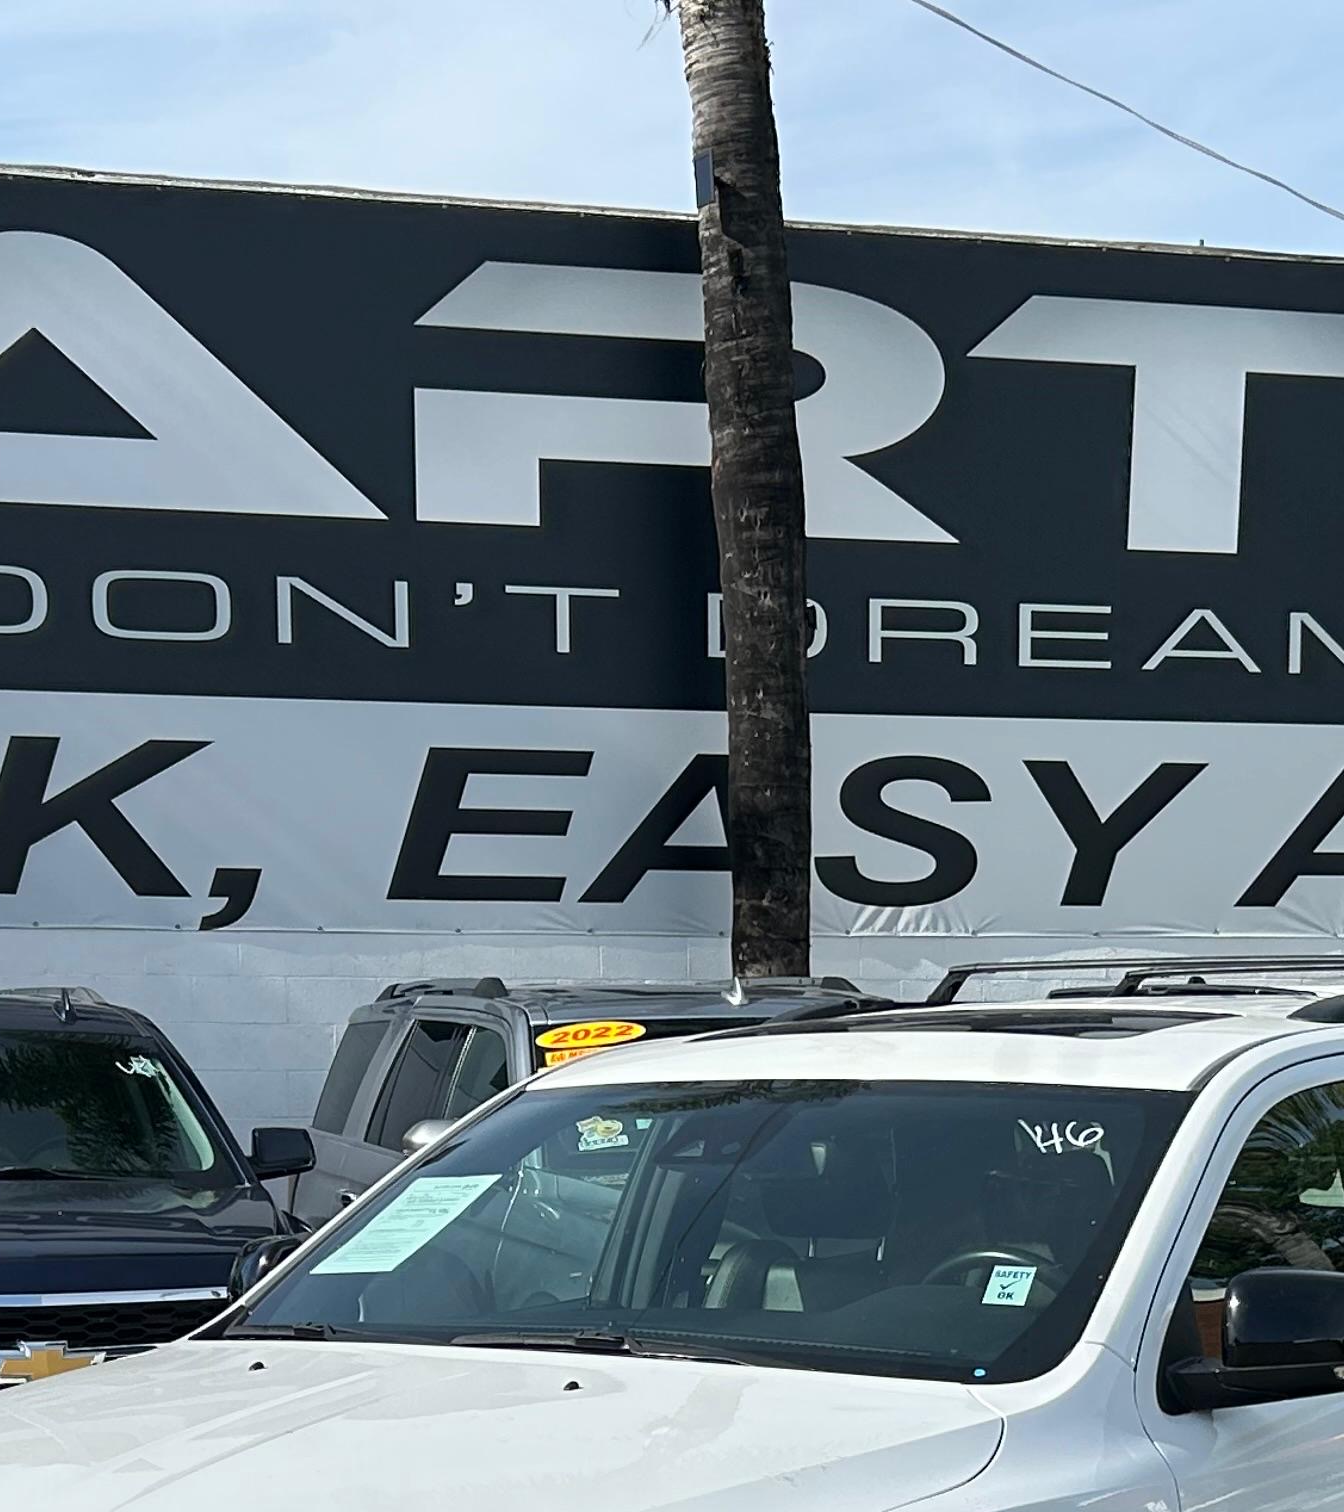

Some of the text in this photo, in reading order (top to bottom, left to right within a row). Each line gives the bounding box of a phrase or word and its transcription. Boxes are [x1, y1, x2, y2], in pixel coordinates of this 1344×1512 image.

[549, 1024, 635, 1045] 2022
[994, 1270, 1033, 1280] SAFETY
[997, 1291, 1015, 1301] OK
